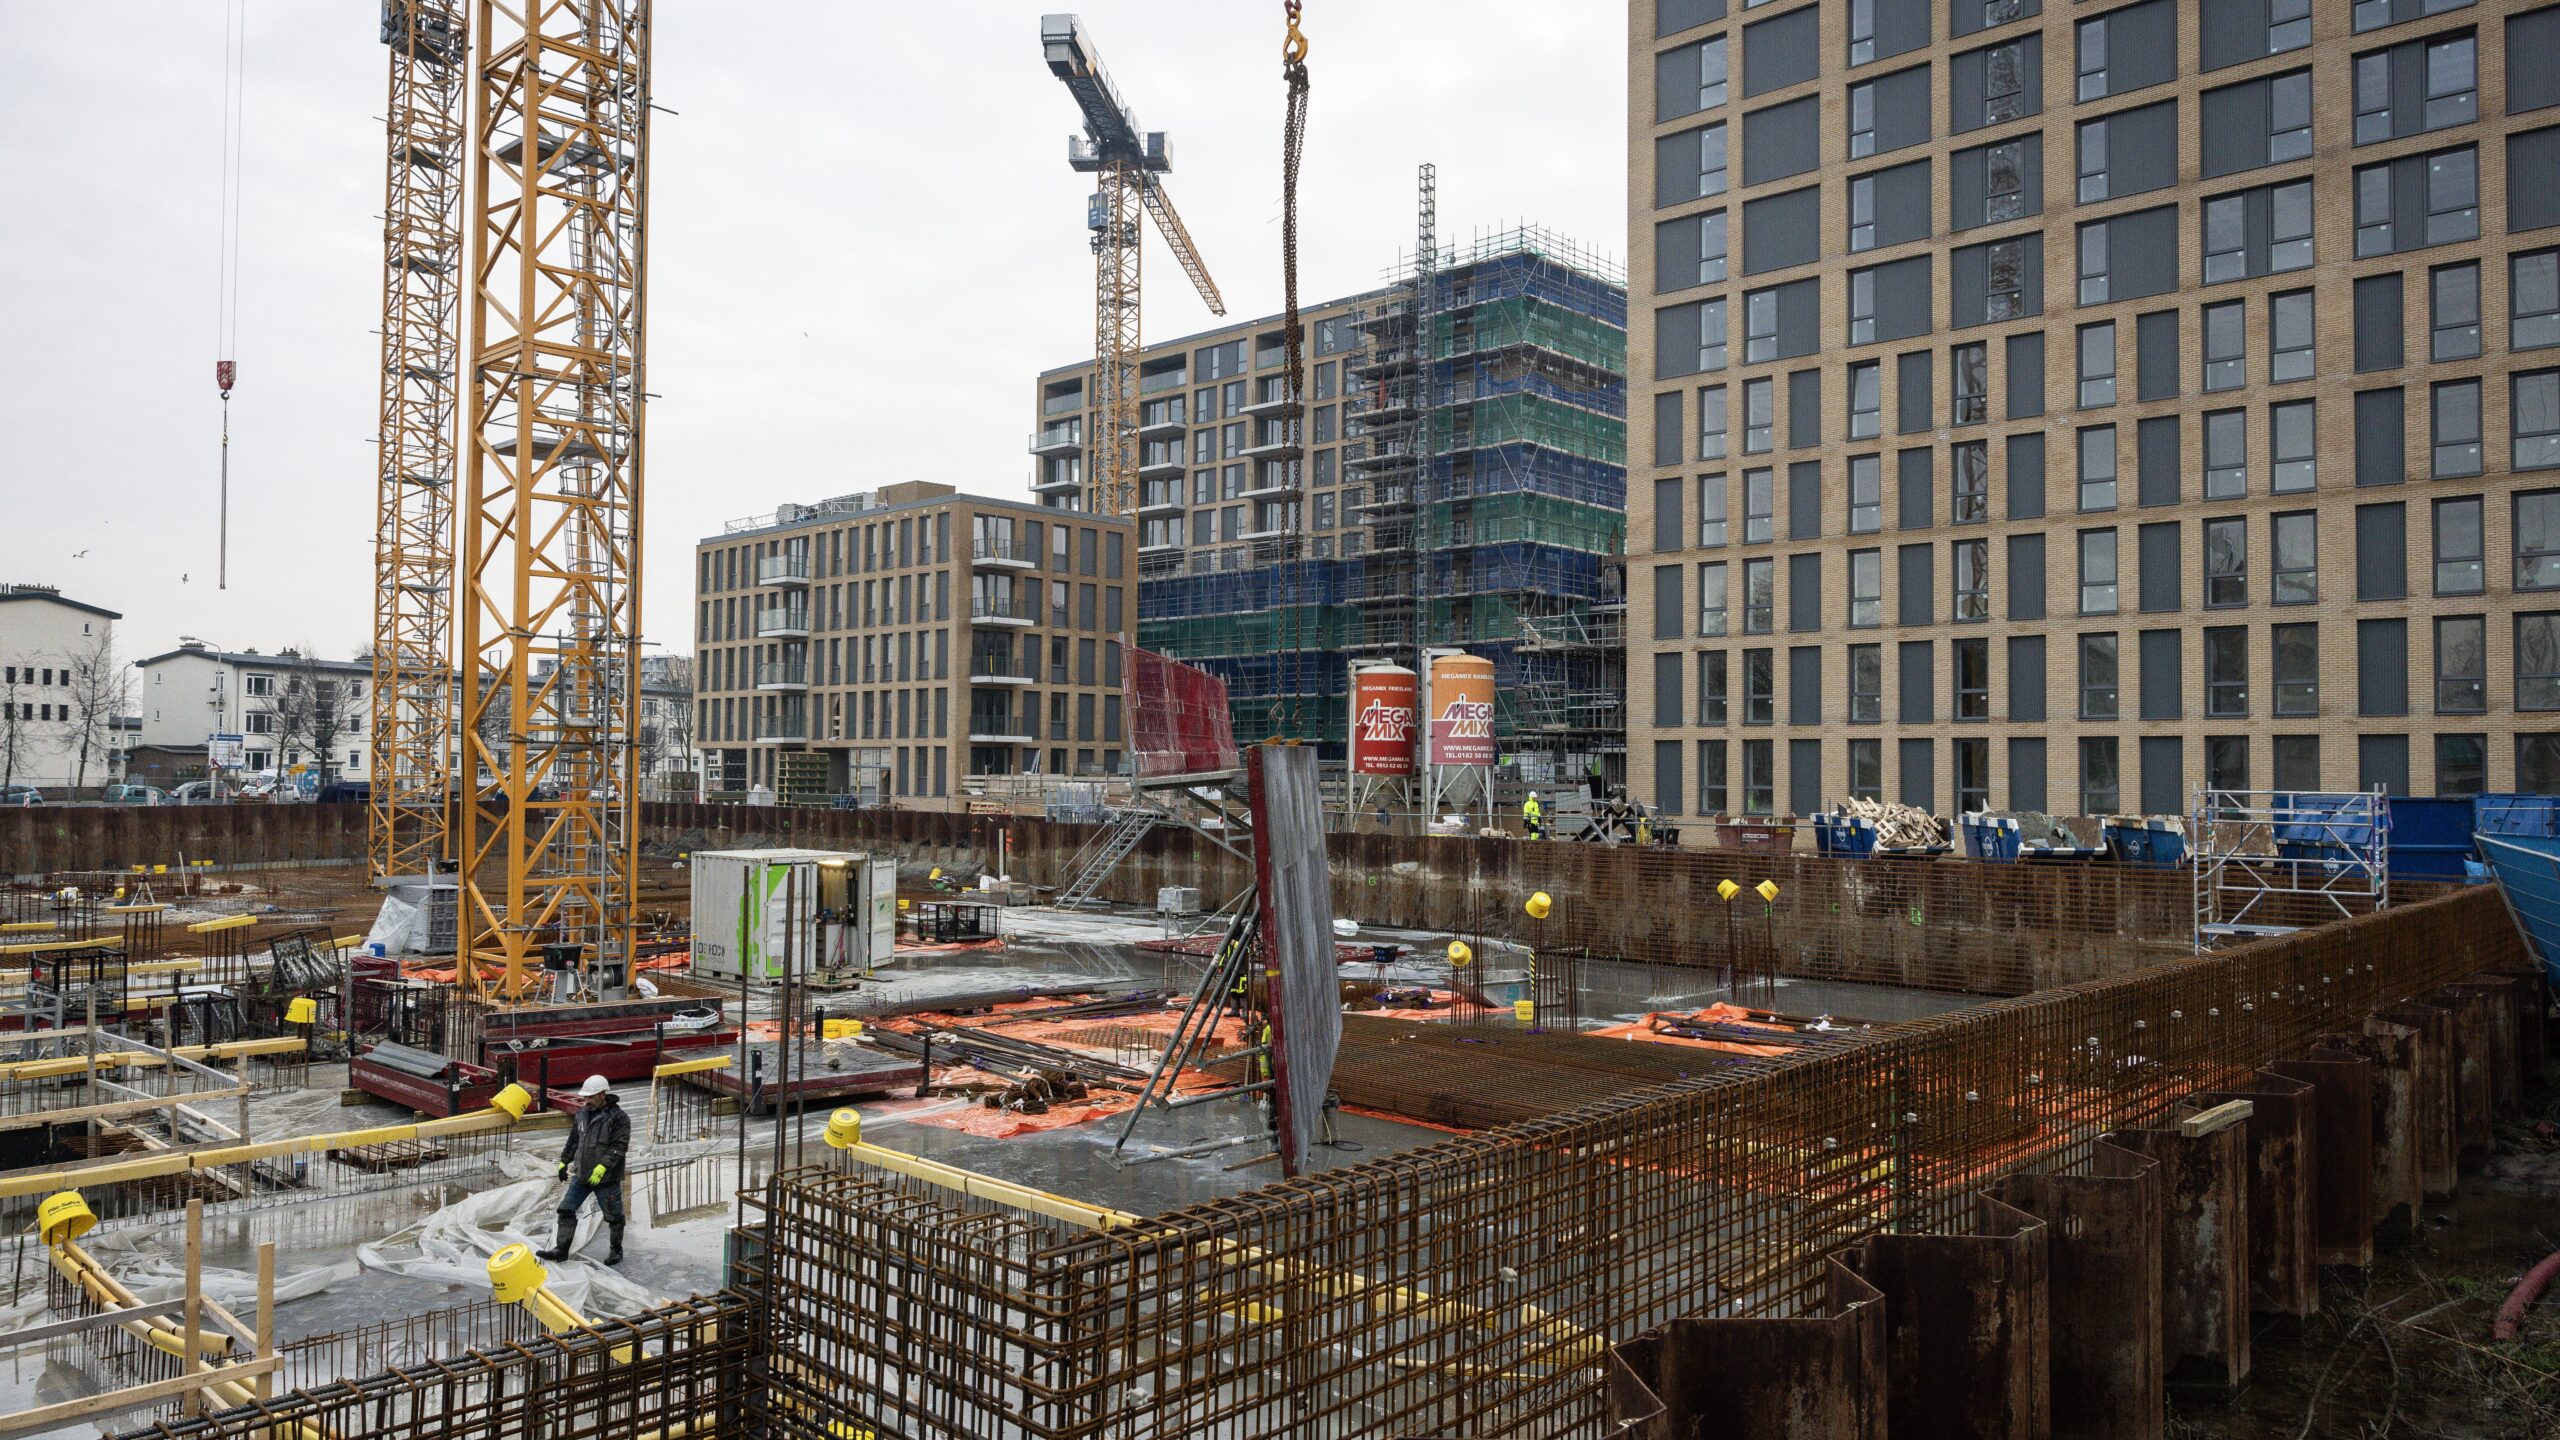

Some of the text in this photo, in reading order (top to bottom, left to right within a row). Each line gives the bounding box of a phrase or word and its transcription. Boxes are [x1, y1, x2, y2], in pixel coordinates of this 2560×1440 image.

[1359, 709, 1412, 724] MEGA
[1443, 703, 1494, 720] MEGA
[1366, 723, 1403, 739] MIX
[1451, 720, 1488, 736] MIX
[1368, 875, 1377, 887] G
